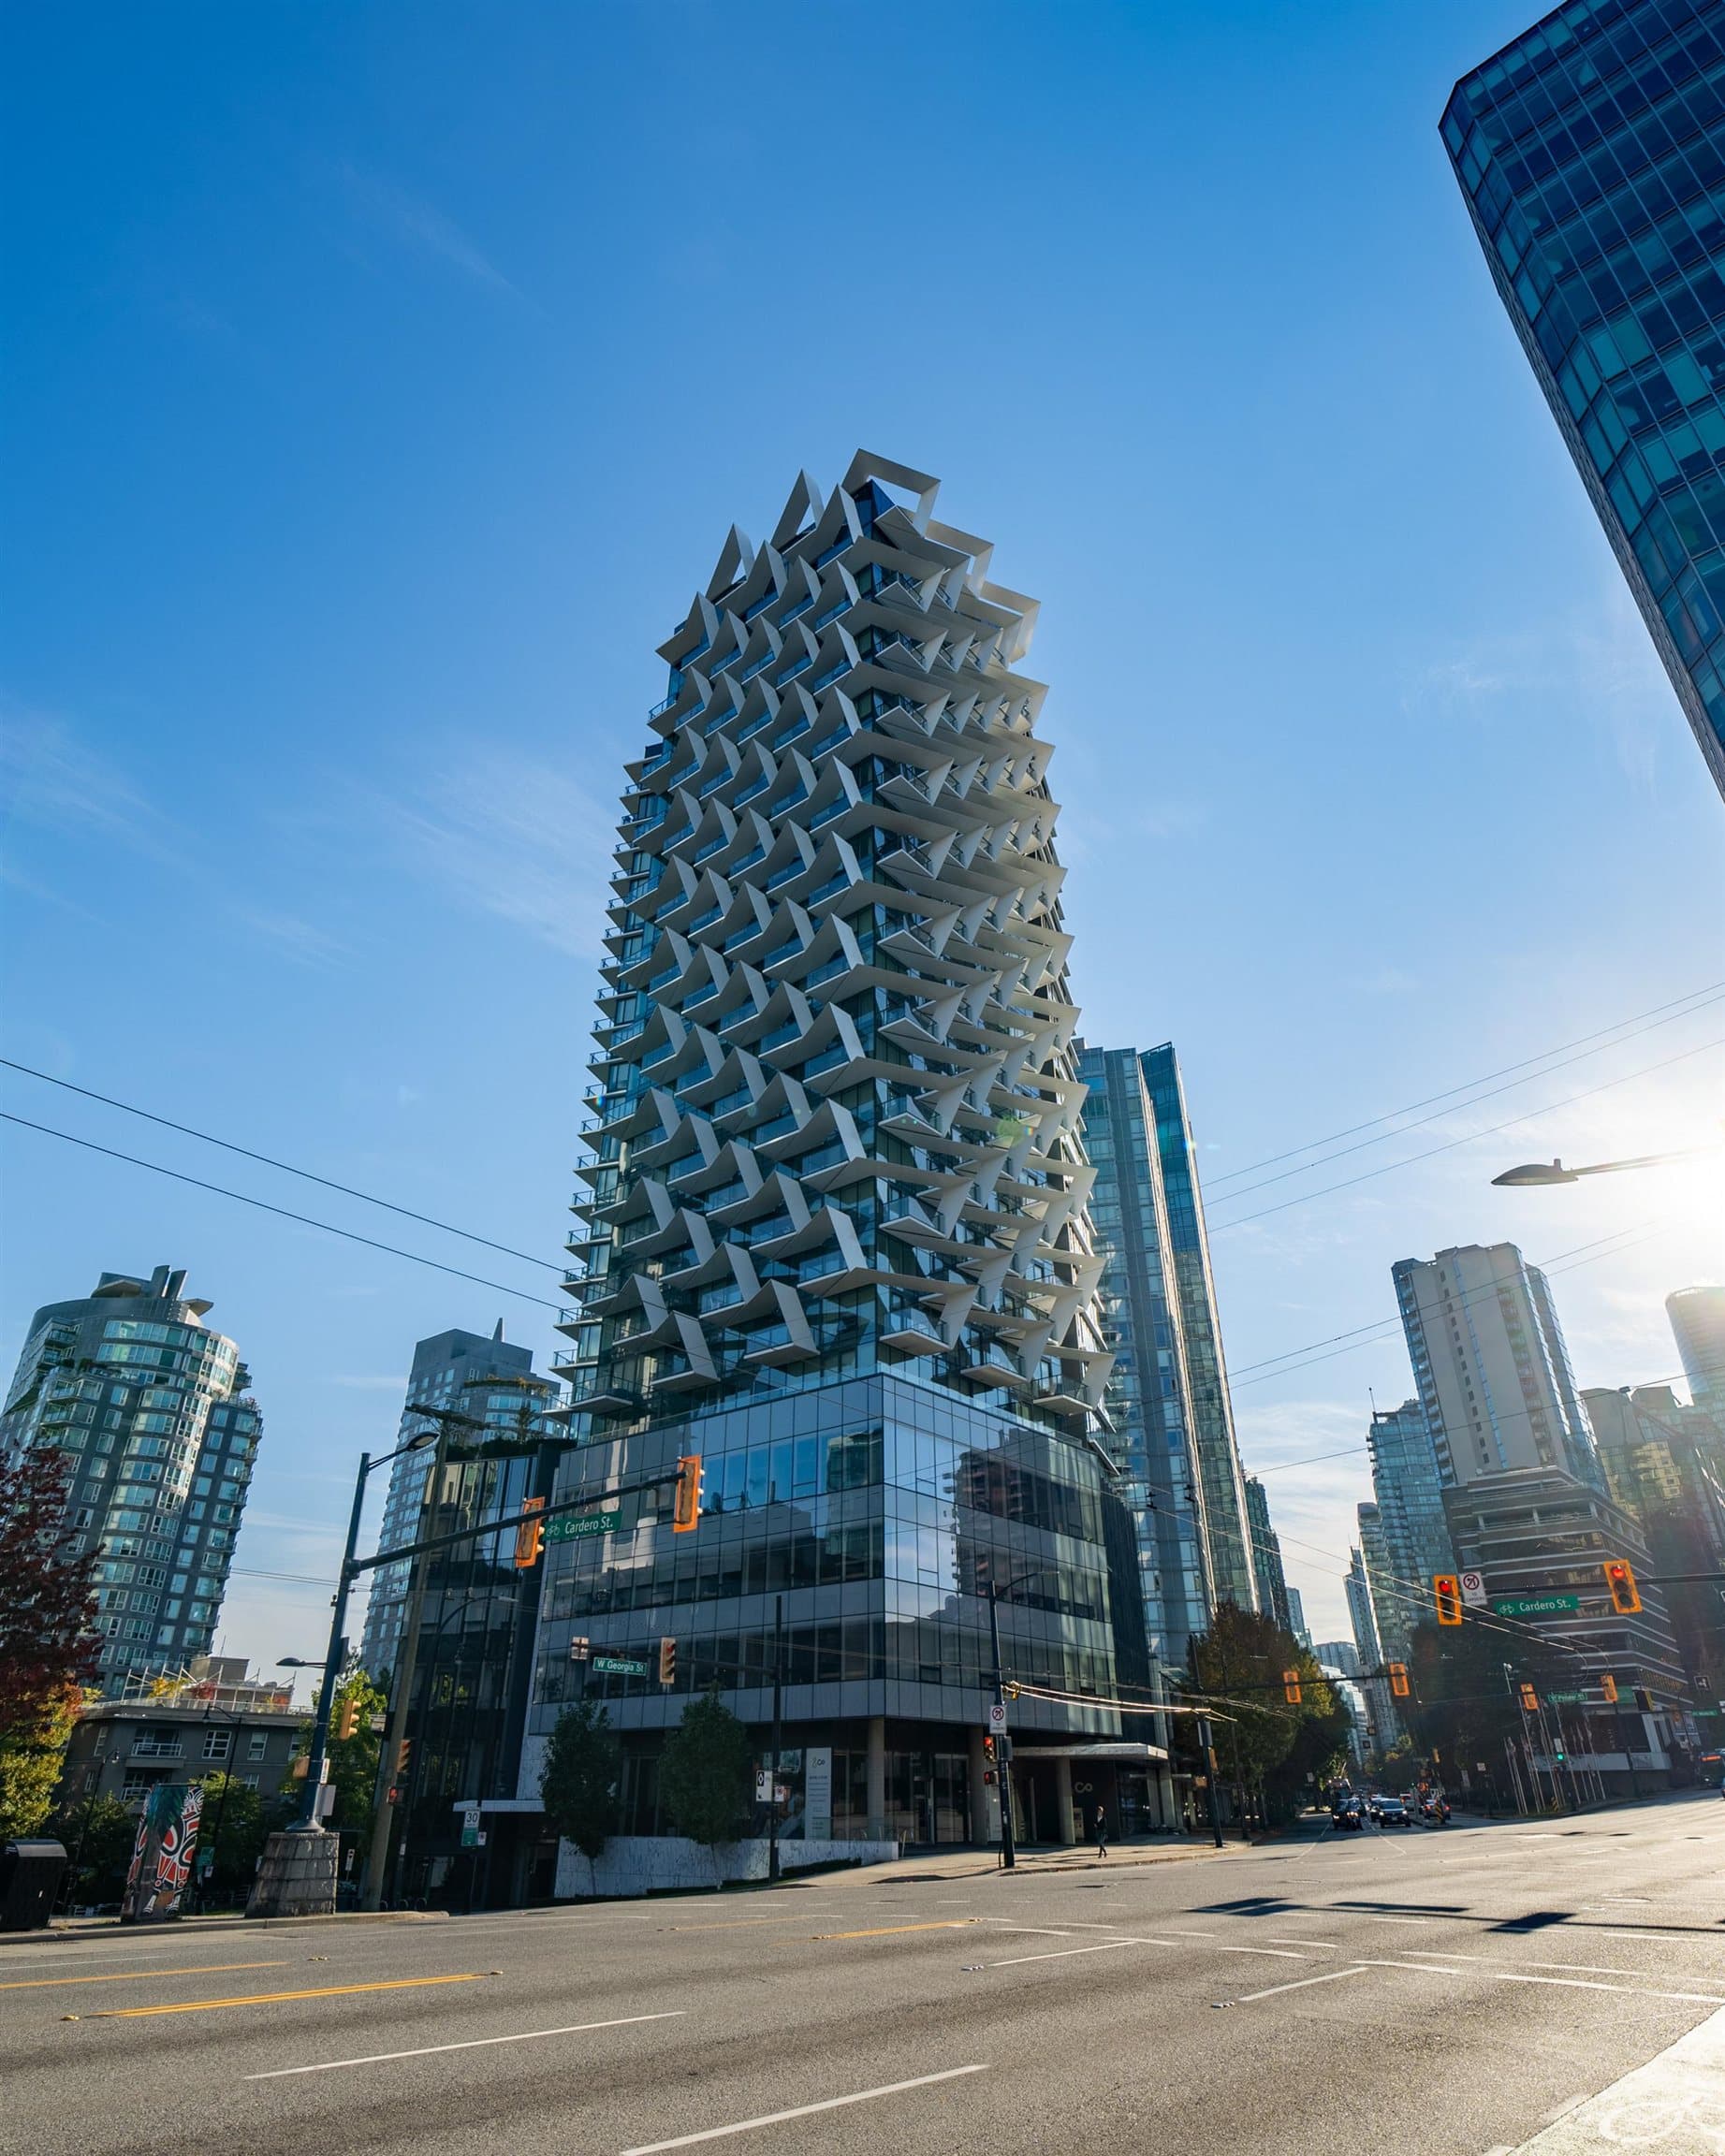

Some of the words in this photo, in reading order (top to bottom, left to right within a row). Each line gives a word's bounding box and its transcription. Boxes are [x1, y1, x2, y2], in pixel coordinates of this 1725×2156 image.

[564, 1519, 599, 1535] Cardero
[600, 1516, 614, 1529] St.
[1519, 1600, 1555, 1611] Cardero
[1556, 1598, 1572, 1609] St.
[597, 1659, 605, 1668] W
[607, 1660, 634, 1672] Georgia
[636, 1663, 644, 1672] St
[466, 1812, 478, 1823] 30
